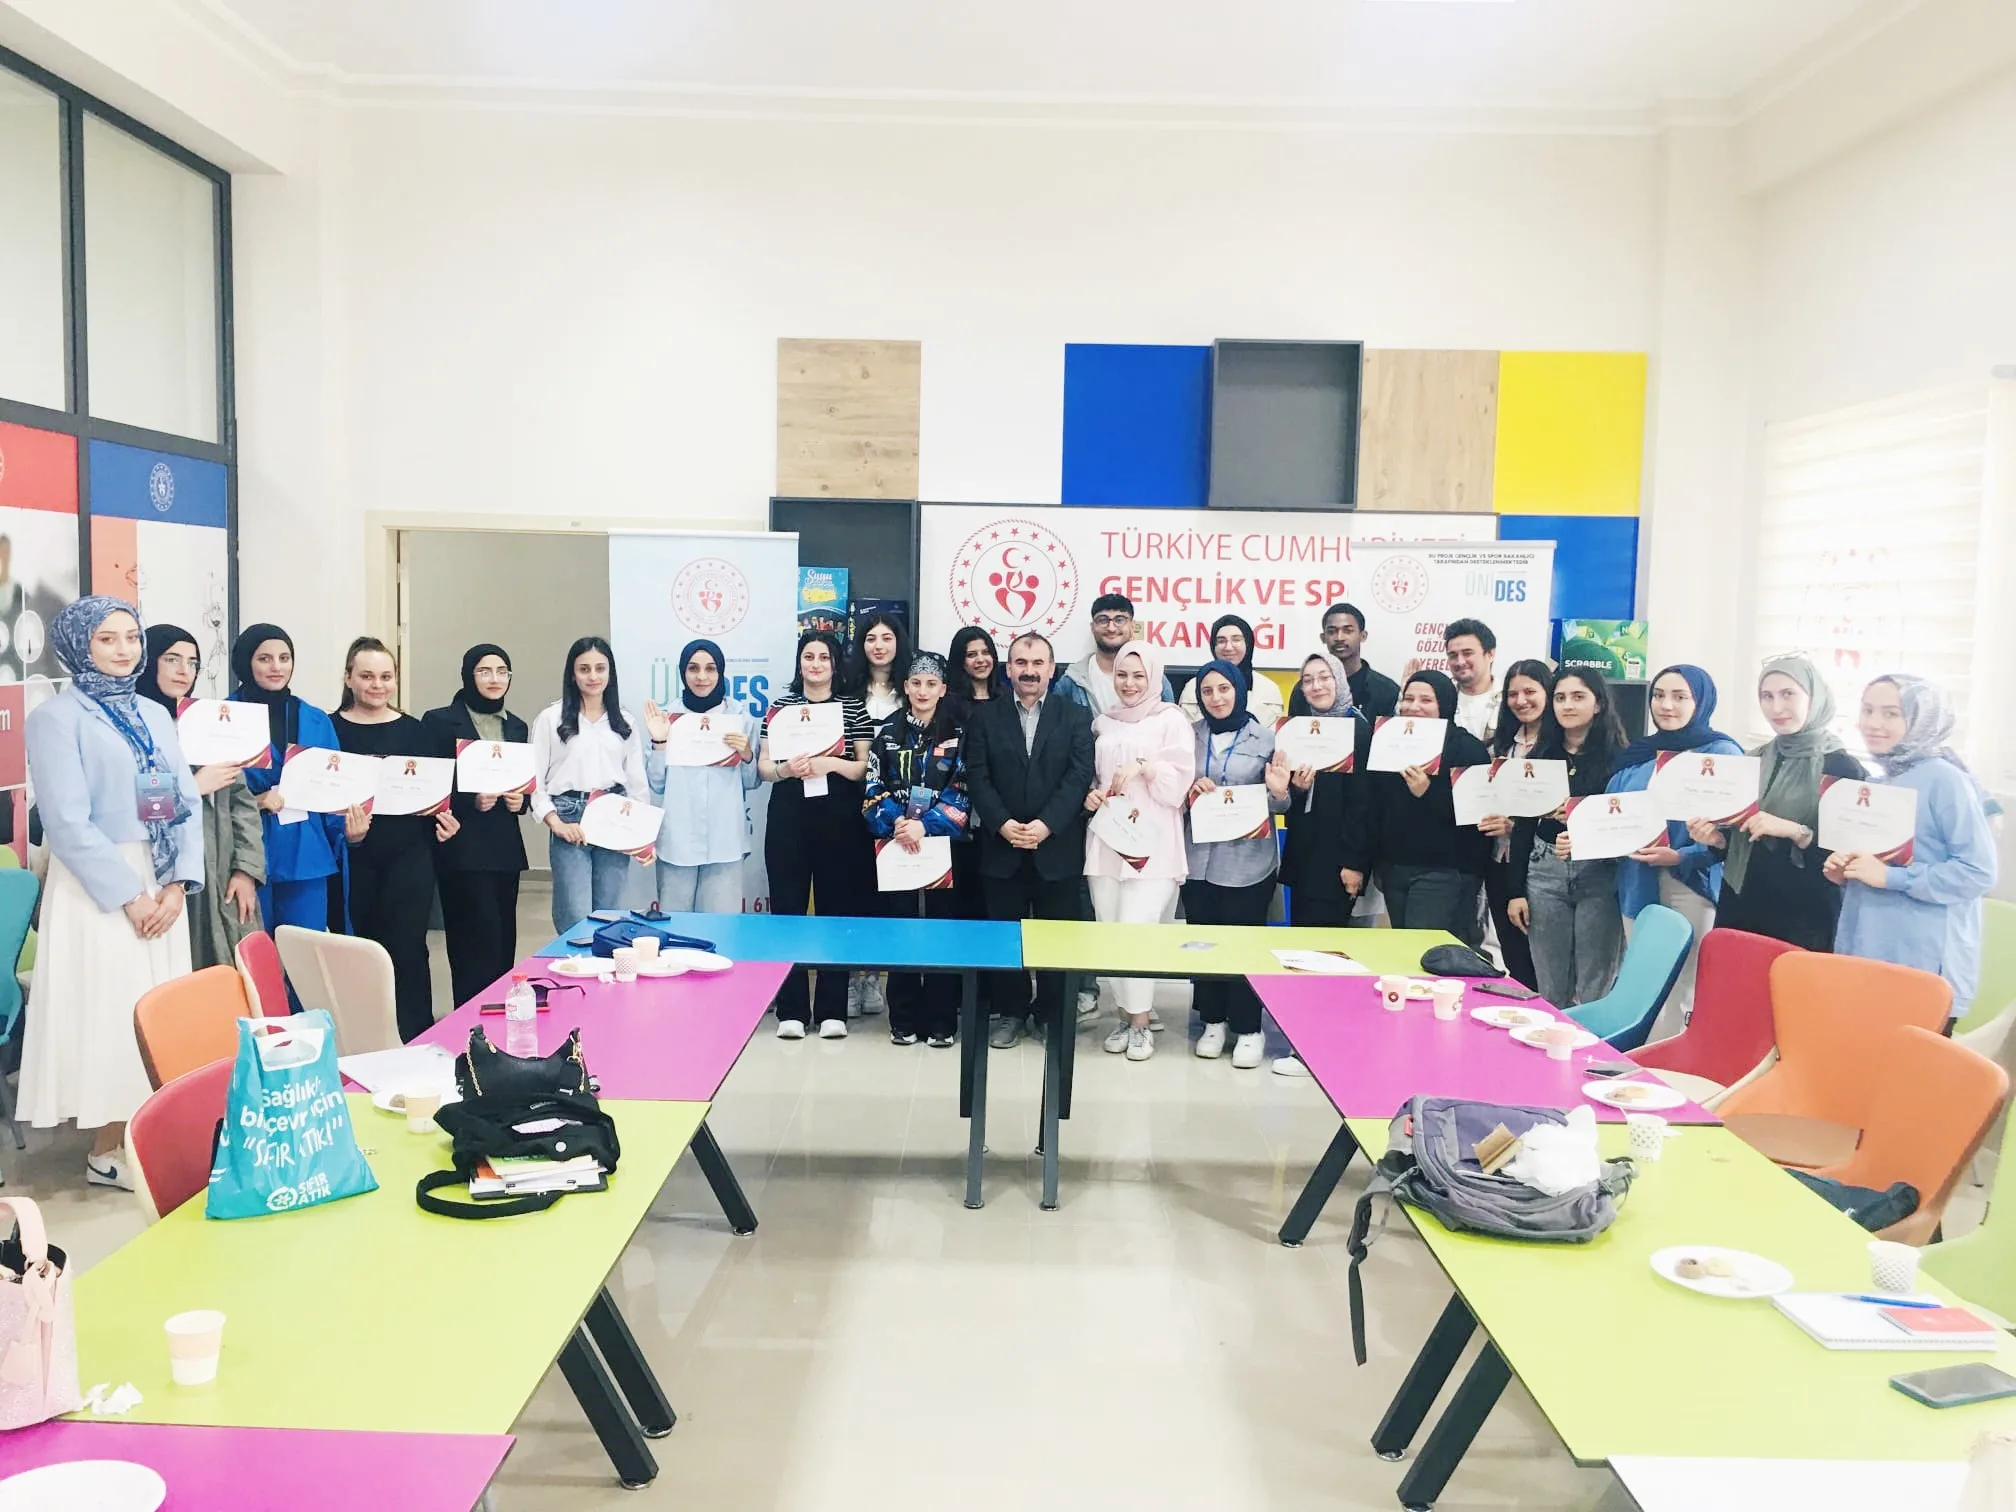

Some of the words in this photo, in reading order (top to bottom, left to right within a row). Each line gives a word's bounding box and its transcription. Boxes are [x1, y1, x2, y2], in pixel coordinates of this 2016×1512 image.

[1100, 526, 1232, 561] TÜRKİYE
[1099, 571, 1247, 612] GENÇLİK
[1254, 579, 1296, 605] VE
[1304, 580, 1350, 607] SP
[1564, 659, 1613, 669] SCRABBLE
[298, 1172, 328, 1194] SIFIR
[298, 1184, 331, 1205] ATIK
